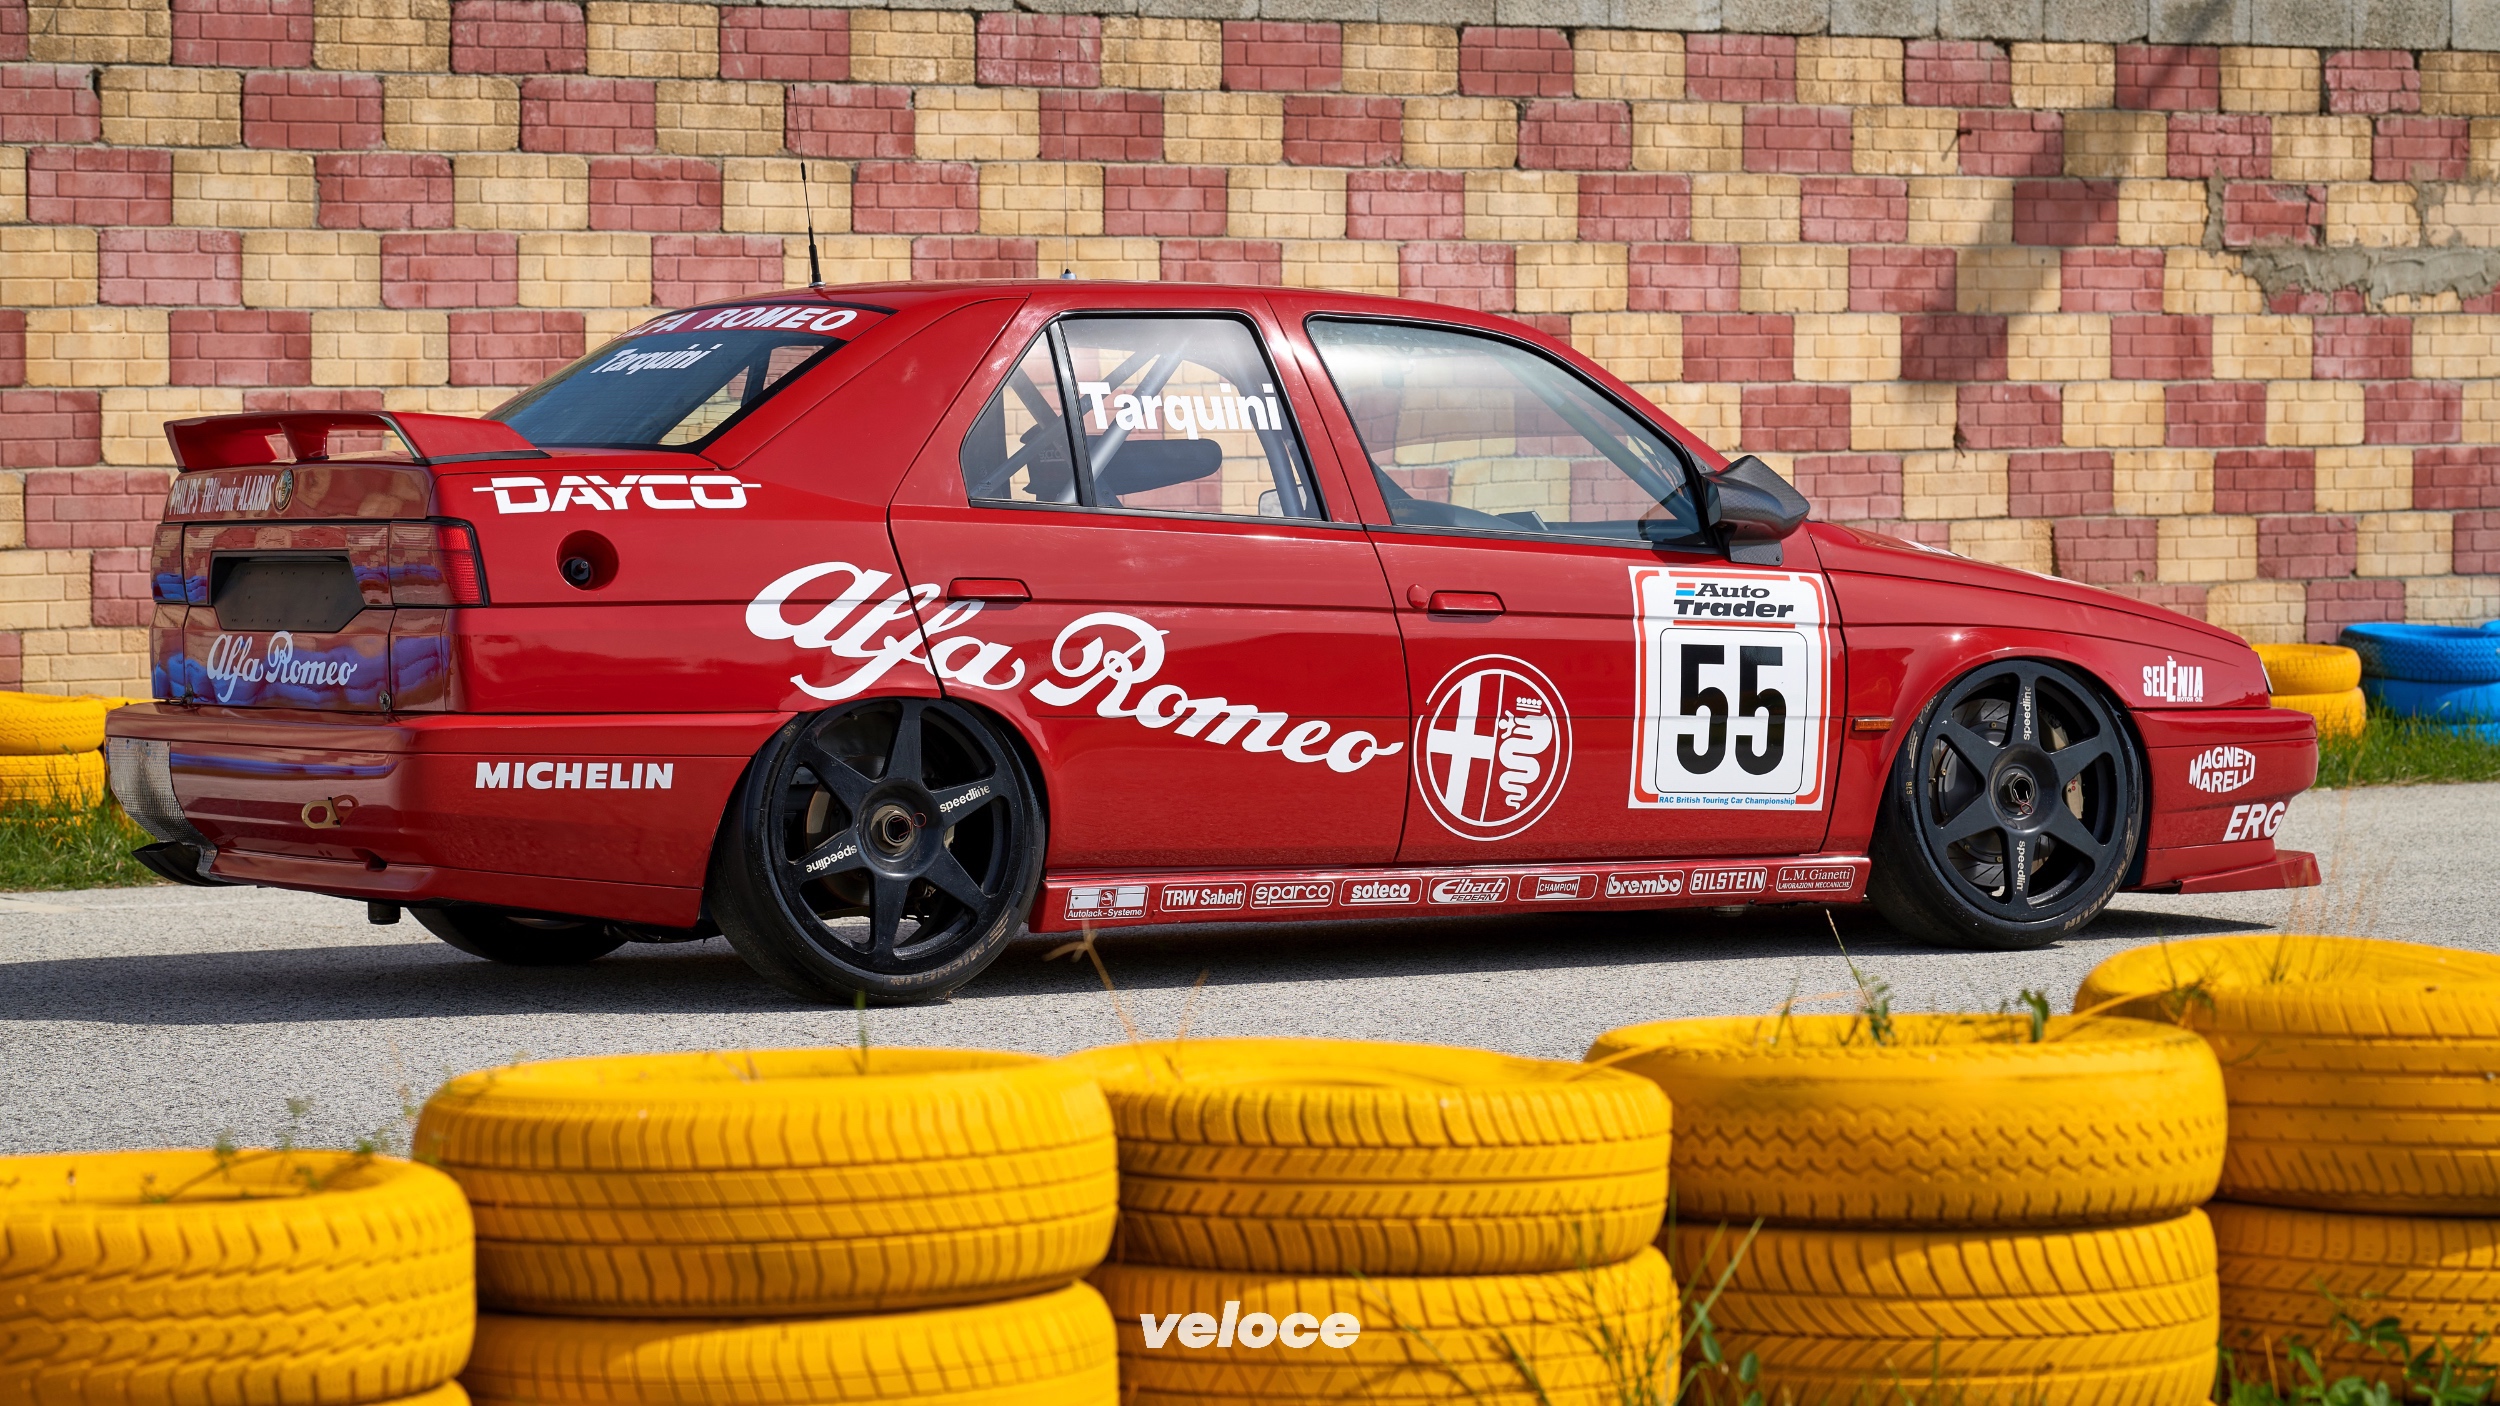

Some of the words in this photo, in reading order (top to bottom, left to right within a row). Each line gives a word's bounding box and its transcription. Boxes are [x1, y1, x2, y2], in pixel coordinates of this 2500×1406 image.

[622, 311, 699, 338] LFA
[693, 306, 858, 332] ROMEO
[590, 343, 724, 375] Tarquini
[1078, 381, 1283, 440] Tarquini
[237, 474, 276, 511] ALARMS
[472, 475, 762, 514] DAYCO
[1695, 583, 1770, 598] Auto
[1674, 599, 1794, 618] Trader
[206, 634, 265, 703] Alfa
[264, 630, 358, 686] Romeo
[745, 561, 1026, 701] Alfa
[1029, 611, 1404, 773] Romeo
[1677, 644, 1786, 775] 55
[475, 762, 674, 790] MICHELIN
[2189, 746, 2256, 782] MAGNETI
[2189, 758, 2255, 793] MARELLI
[939, 785, 991, 813] speedline
[1659, 796, 1674, 804] RAC
[1676, 796, 1701, 804] British
[1702, 796, 1729, 806] Touring
[1730, 796, 1743, 804] Car
[1745, 797, 1796, 806] Championship
[2222, 801, 2286, 842] ERG
[806, 845, 858, 873] speedline
[2016, 840, 2025, 892] speedlin
[1538, 882, 1578, 892] CHAMPION
[1607, 874, 1682, 895] brembo
[1691, 871, 1767, 891] BILSTEIN
[1778, 882, 1814, 890] LAVORAZIONI
[1814, 881, 1850, 889] MECCANICHE
[1809, 868, 1851, 880] Gianetti
[1165, 889, 1199, 907] TRW
[1200, 888, 1244, 906] Sabelt
[1255, 884, 1331, 905] sparco
[1351, 881, 1411, 899] soteco
[1432, 879, 1506, 902] Eibach
[1450, 893, 1496, 902] FEDERN
